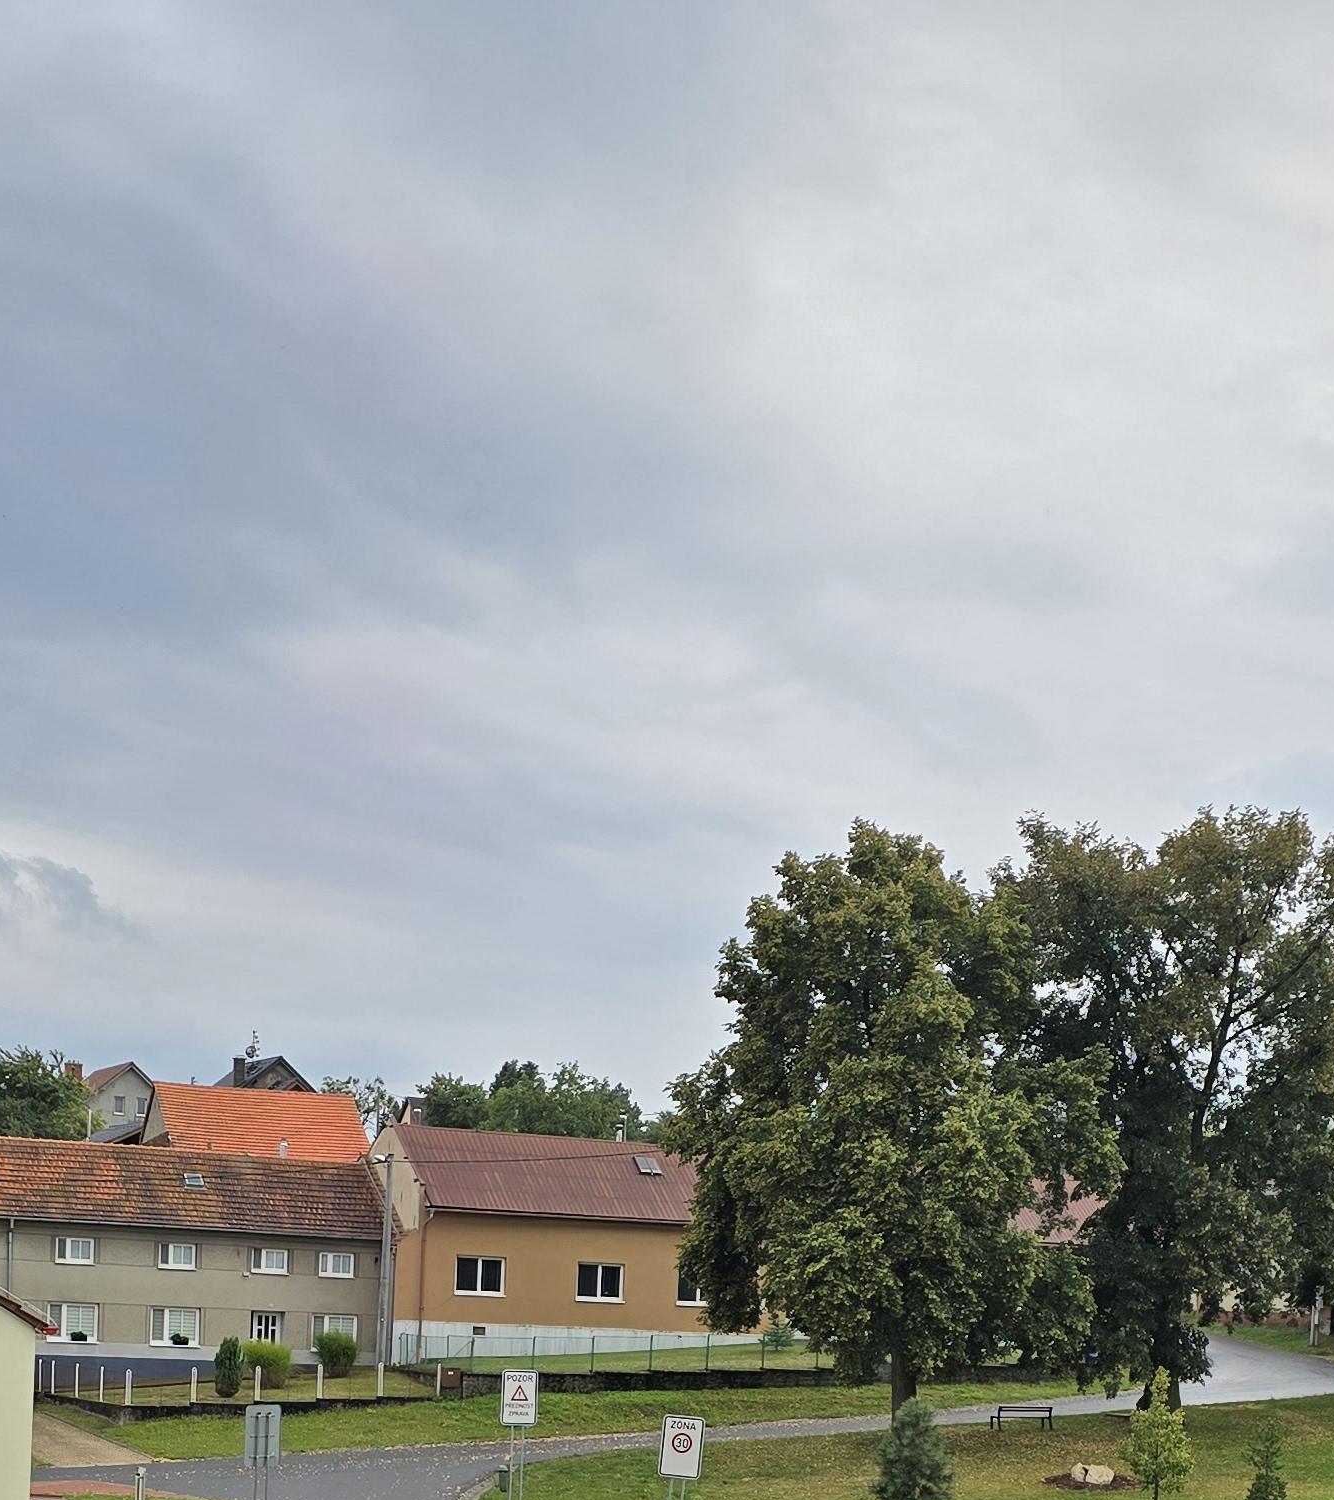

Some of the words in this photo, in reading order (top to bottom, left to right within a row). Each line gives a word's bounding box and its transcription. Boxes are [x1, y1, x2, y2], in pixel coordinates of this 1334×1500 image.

[507, 1374, 534, 1383] POZOR
[670, 1420, 696, 1430] ZONA
[675, 1437, 689, 1449] 30
